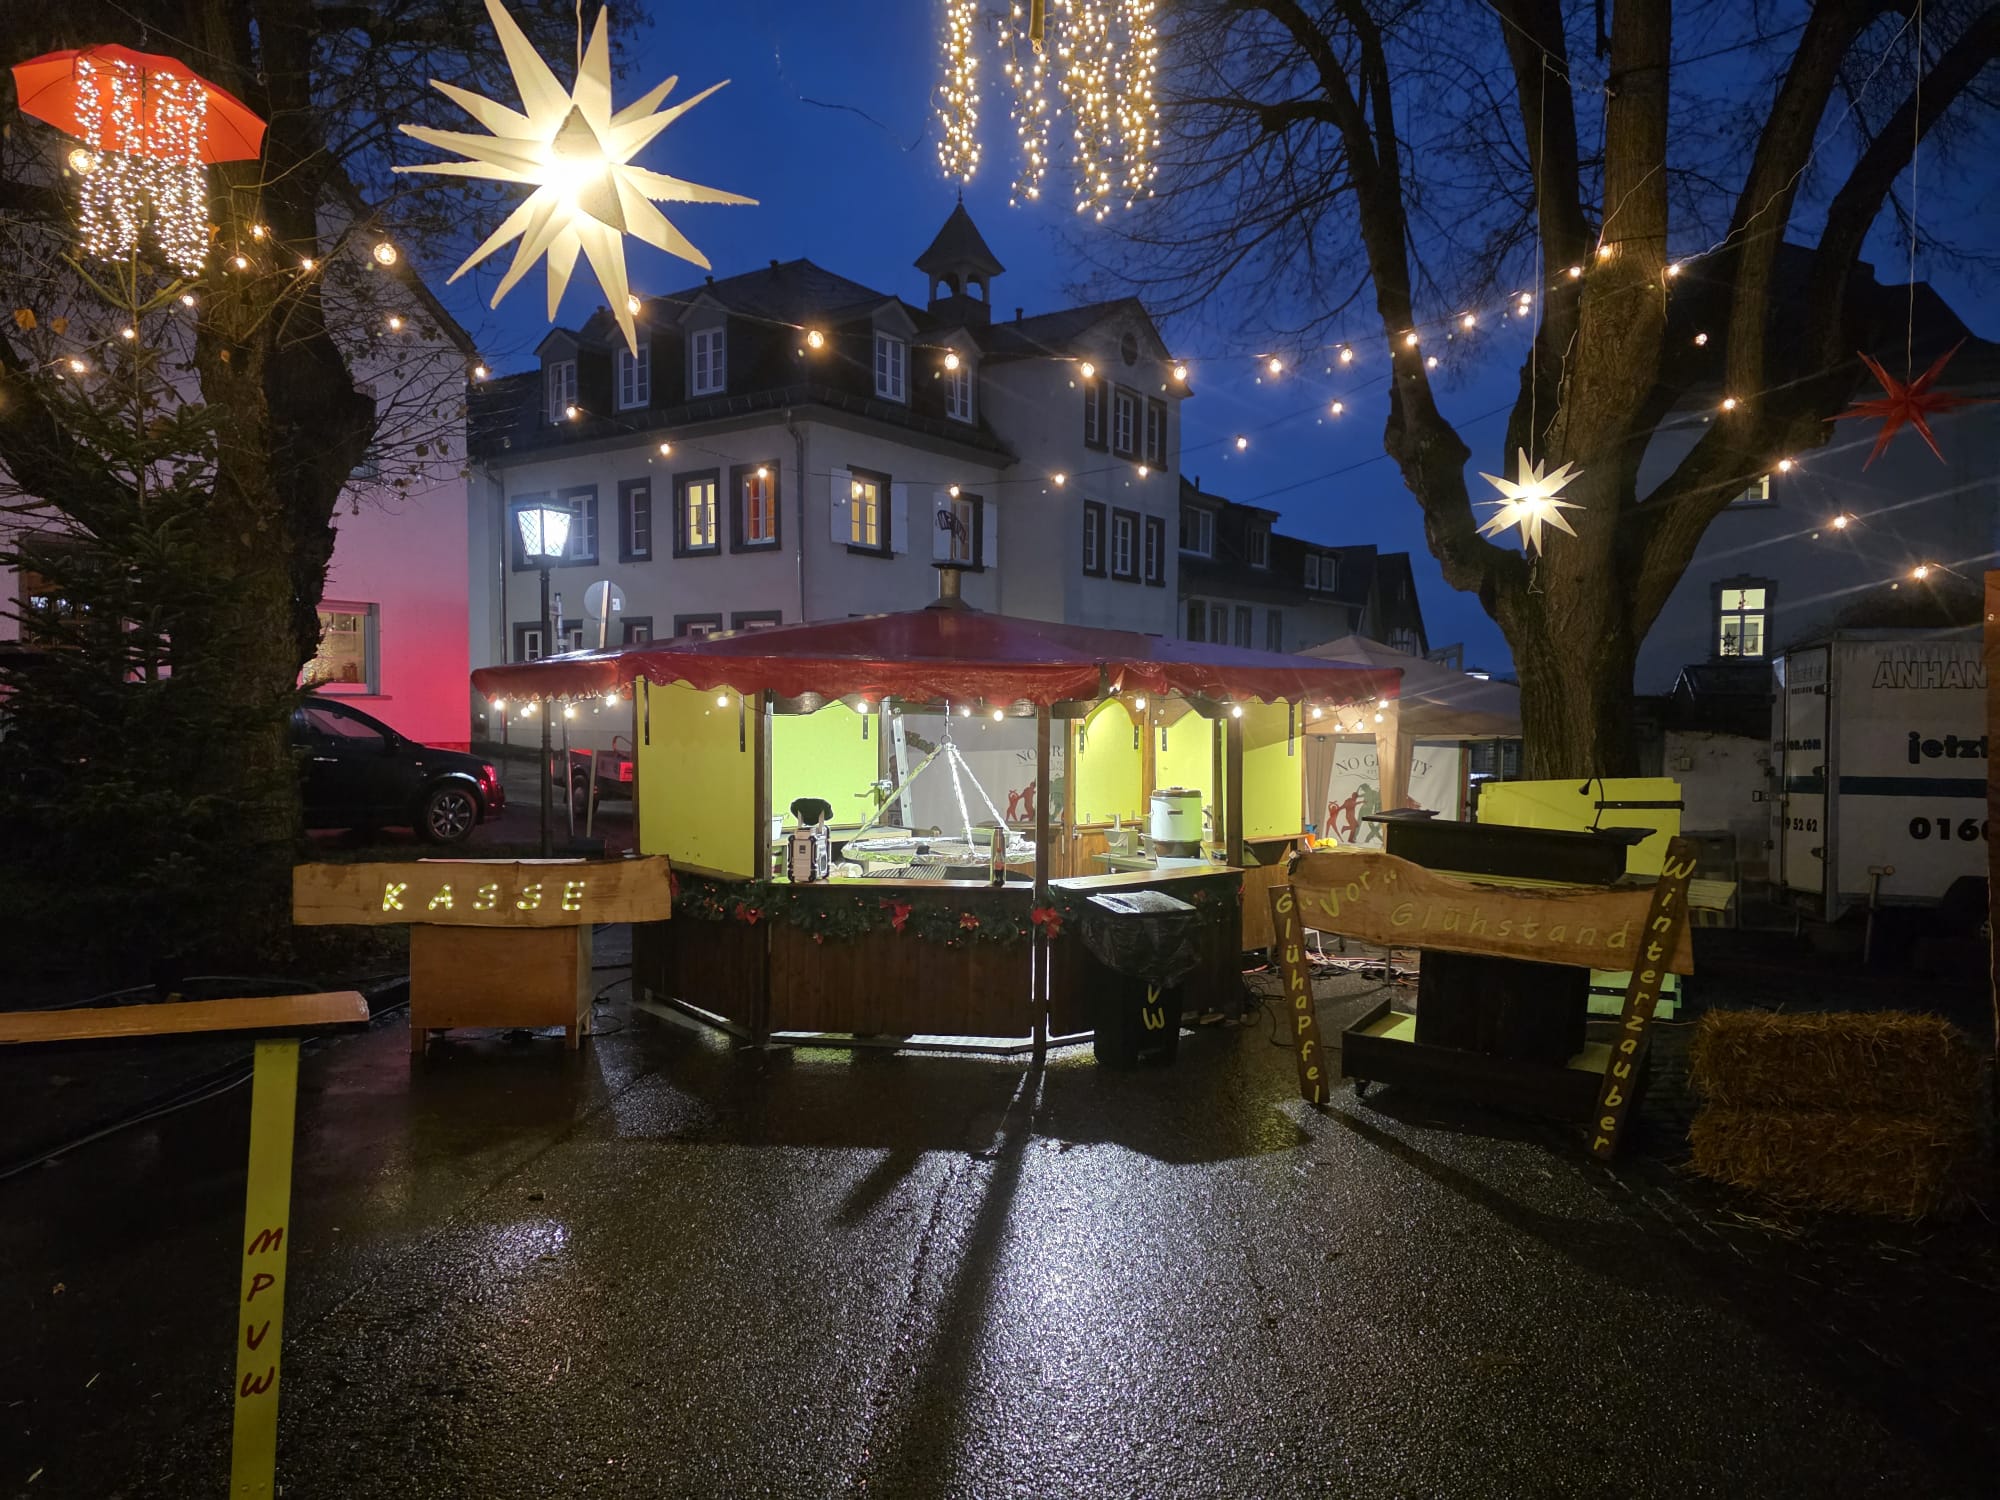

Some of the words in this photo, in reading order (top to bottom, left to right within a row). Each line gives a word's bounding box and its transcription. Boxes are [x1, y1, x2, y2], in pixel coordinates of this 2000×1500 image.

[1335, 757, 1360, 771] NO
[1793, 818, 1804, 831] 52
[1806, 818, 1818, 833] 62
[381, 881, 587, 912] KASSE
[1390, 902, 1631, 949] Glühstand
[1275, 892, 1320, 1104] Glühapfel
[1592, 855, 1697, 1151] Winterzauber
